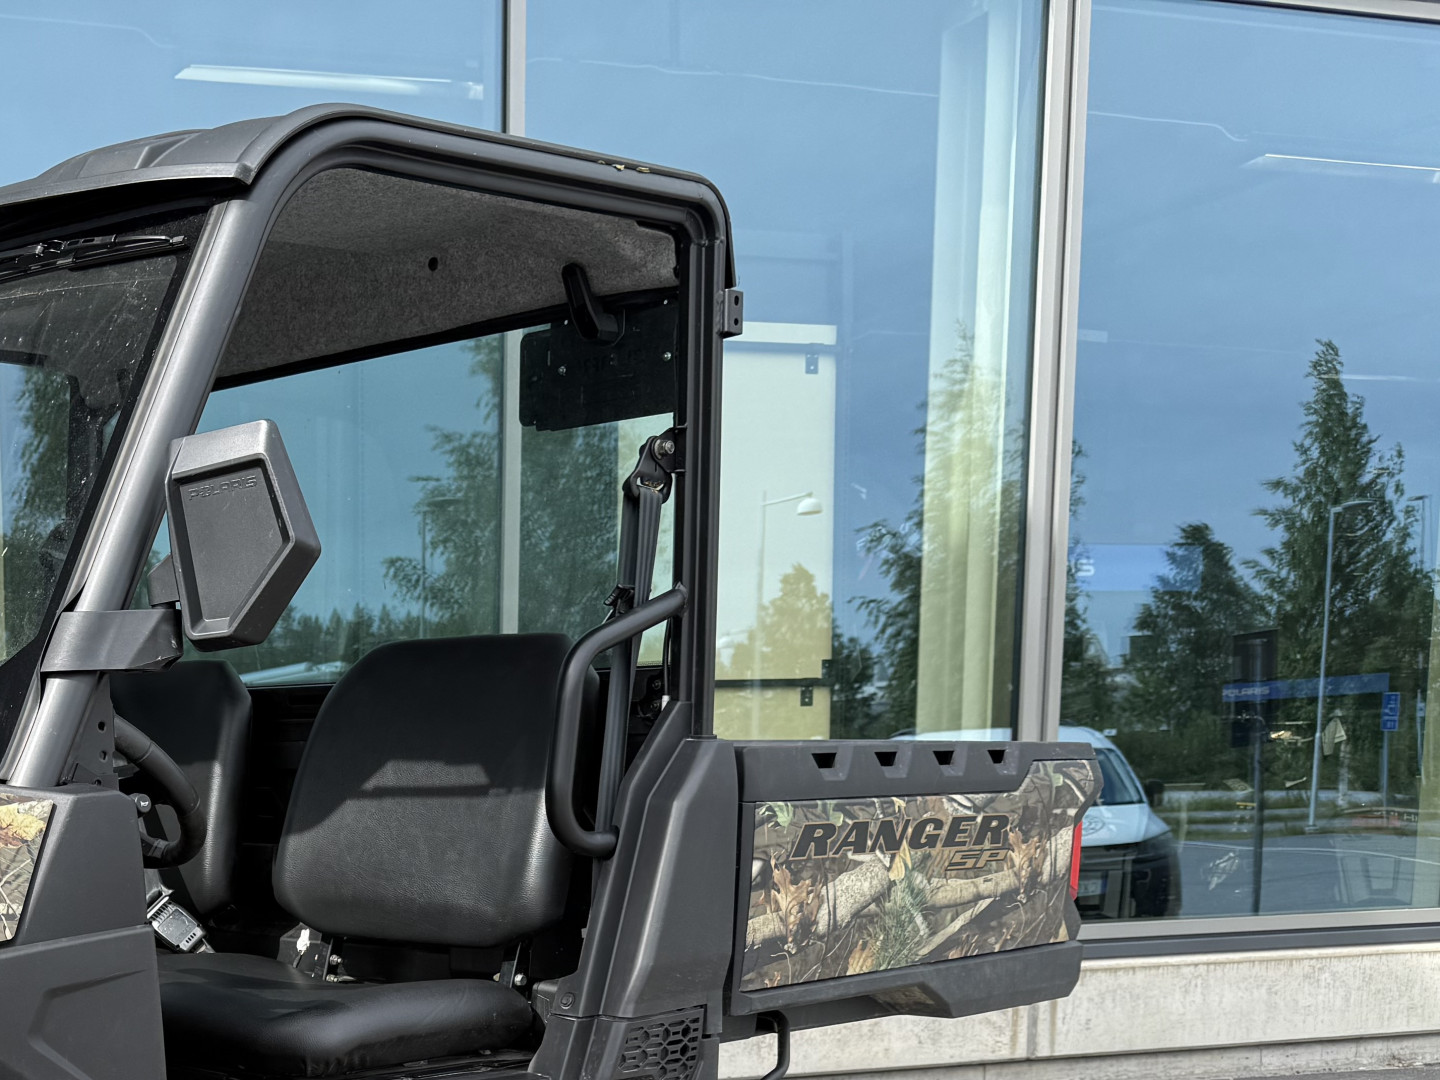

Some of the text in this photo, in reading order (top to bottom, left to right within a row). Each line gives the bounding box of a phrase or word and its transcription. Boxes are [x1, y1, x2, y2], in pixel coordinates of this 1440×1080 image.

[187, 473, 258, 503] POLARIS
[789, 813, 1014, 861] RANGER
[945, 848, 1012, 872] SP
